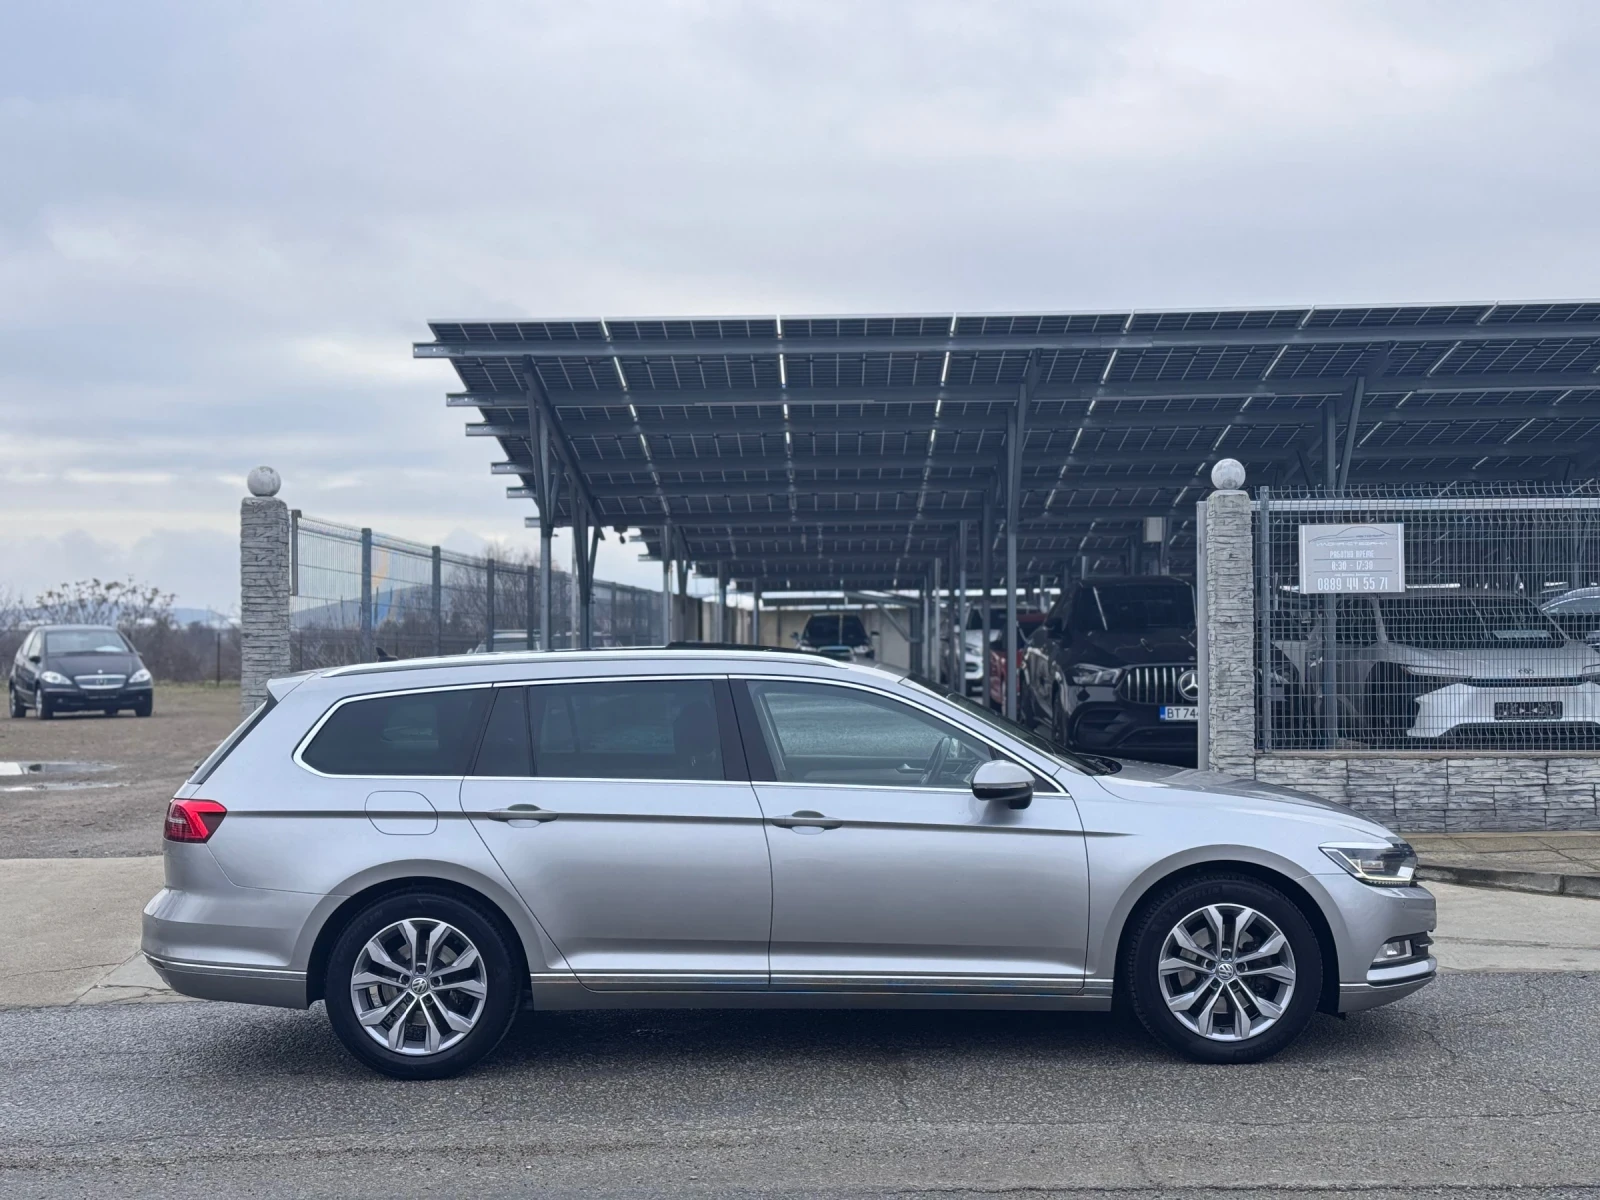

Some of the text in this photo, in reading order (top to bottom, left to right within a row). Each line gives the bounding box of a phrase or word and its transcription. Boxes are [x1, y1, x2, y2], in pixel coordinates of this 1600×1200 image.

[1317, 576, 1388, 591] 0889 44 55 71
[1167, 708, 1198, 718] BT 74
